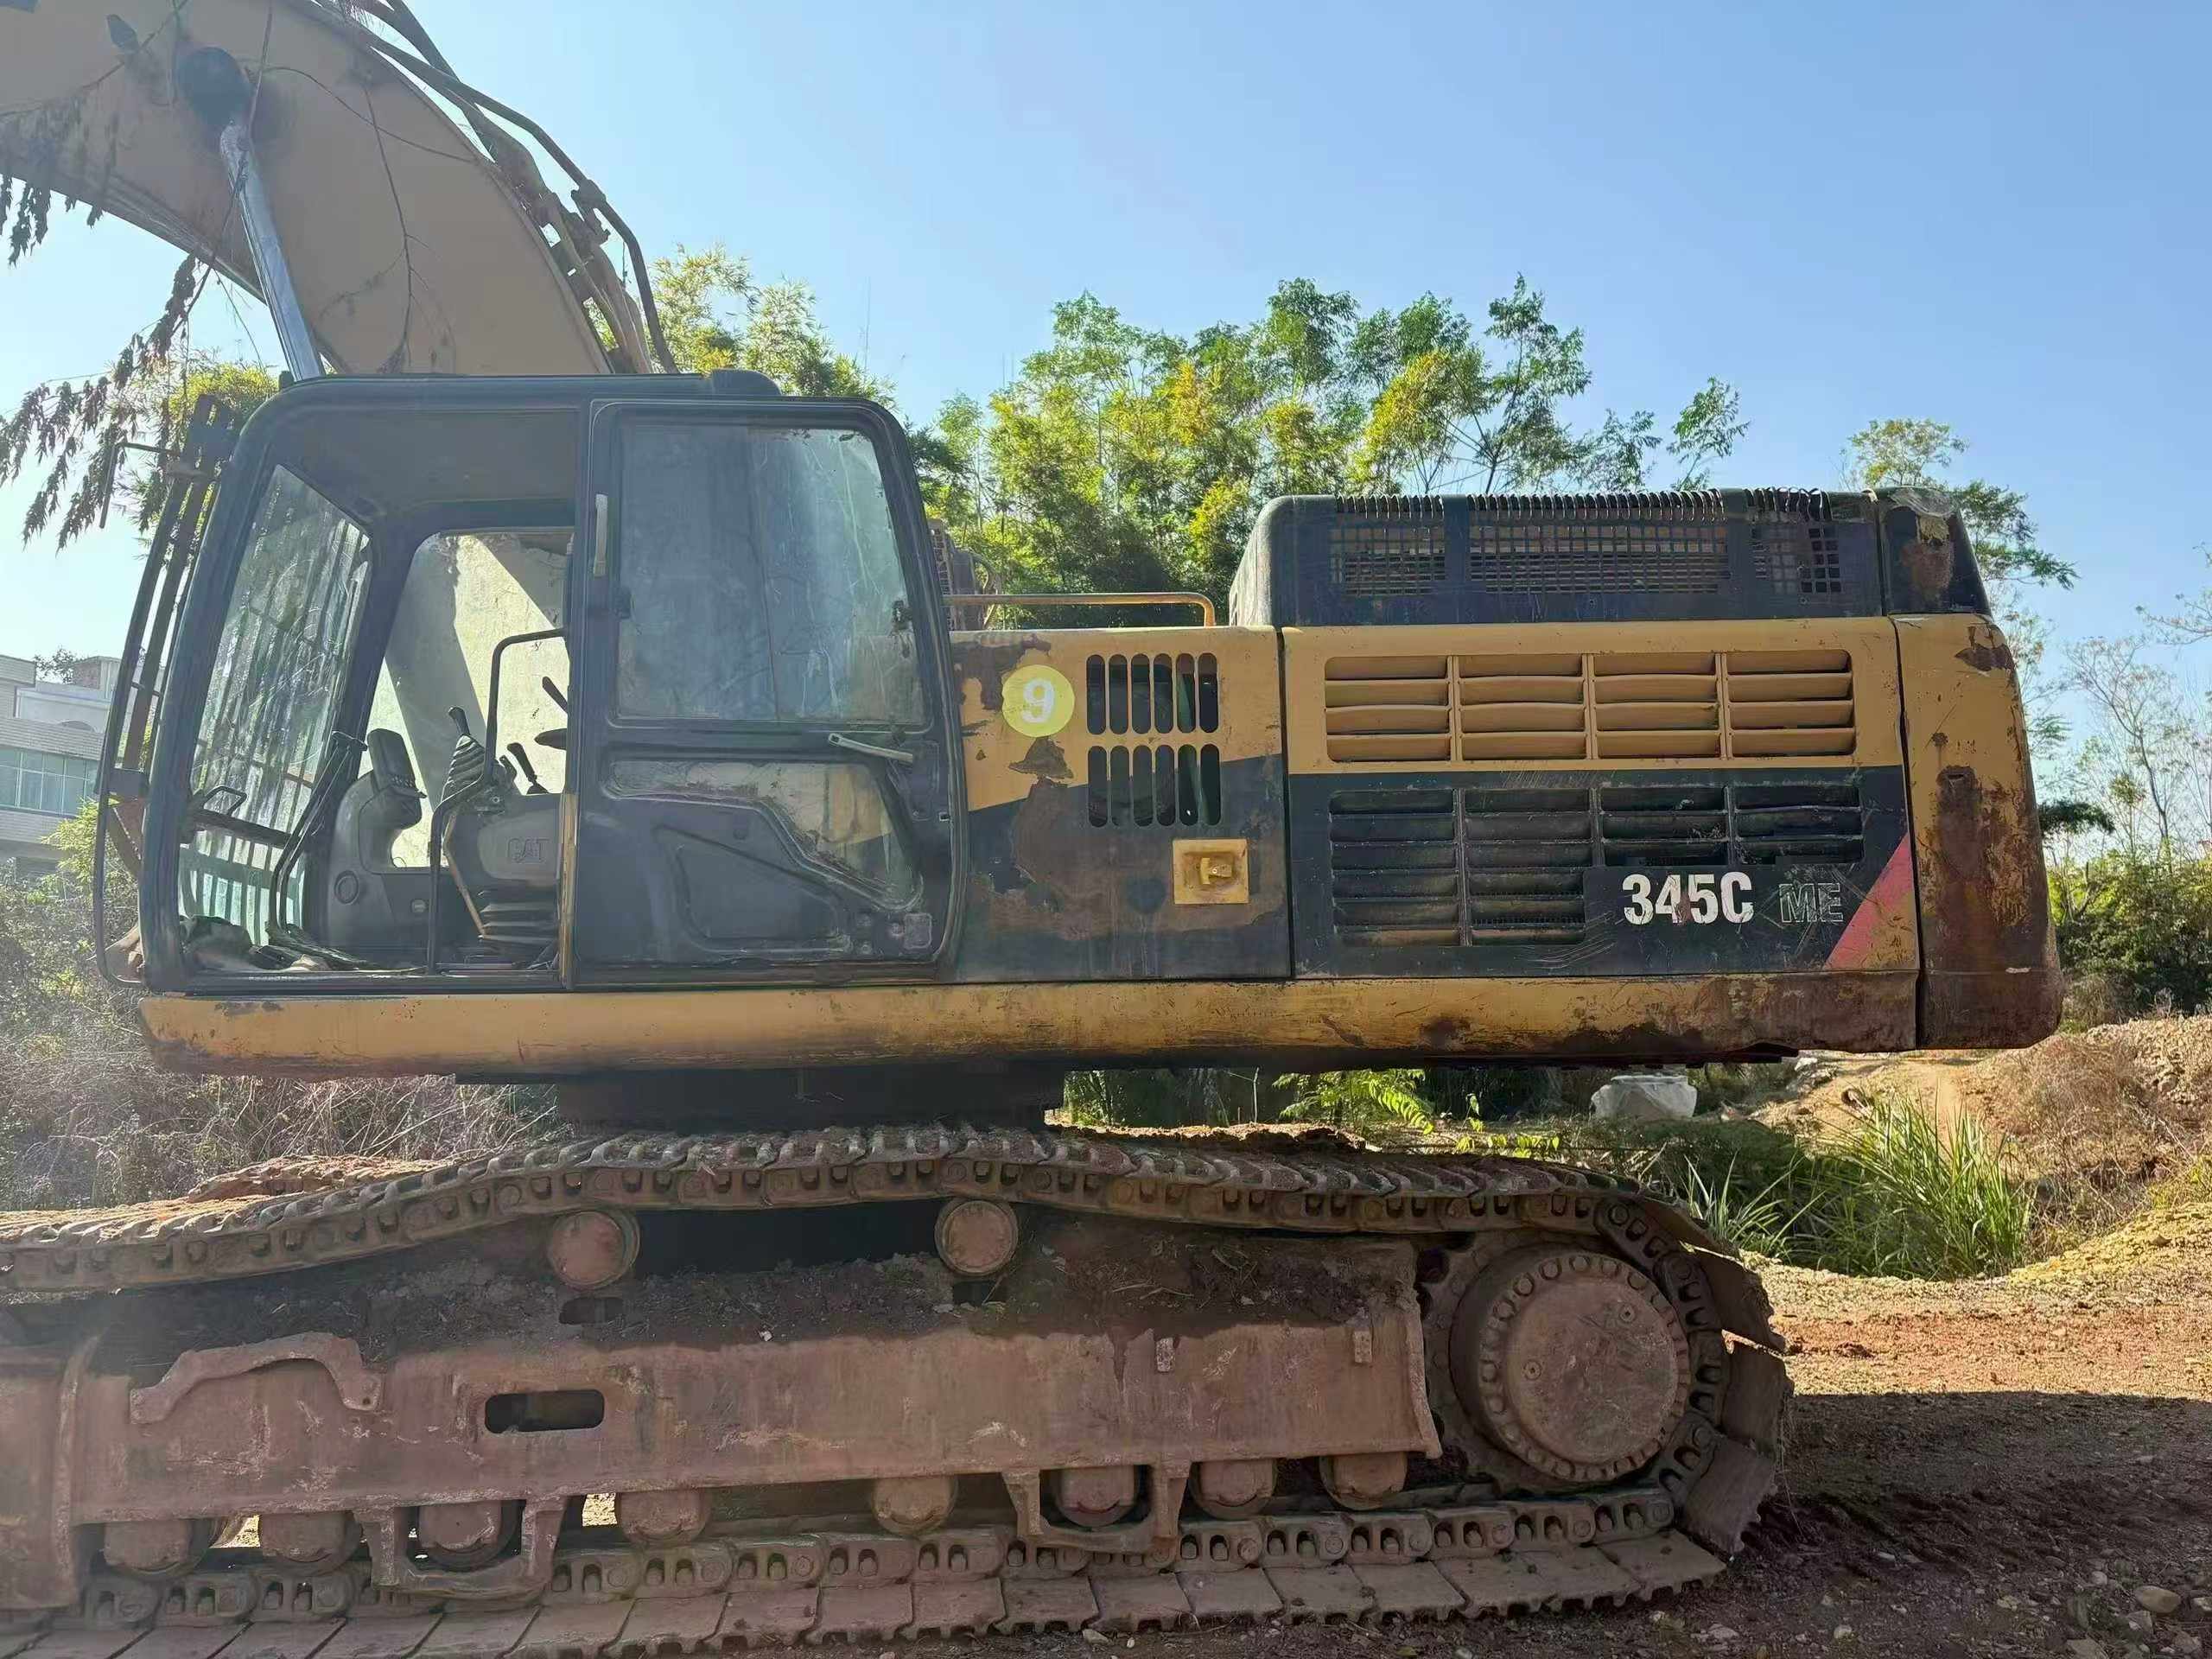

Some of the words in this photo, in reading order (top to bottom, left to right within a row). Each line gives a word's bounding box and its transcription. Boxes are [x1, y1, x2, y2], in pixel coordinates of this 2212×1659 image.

[1022, 677, 1055, 723] 9
[507, 838, 550, 863] CAT
[1622, 872, 1754, 925] 345C
[1778, 882, 1844, 923] ME
